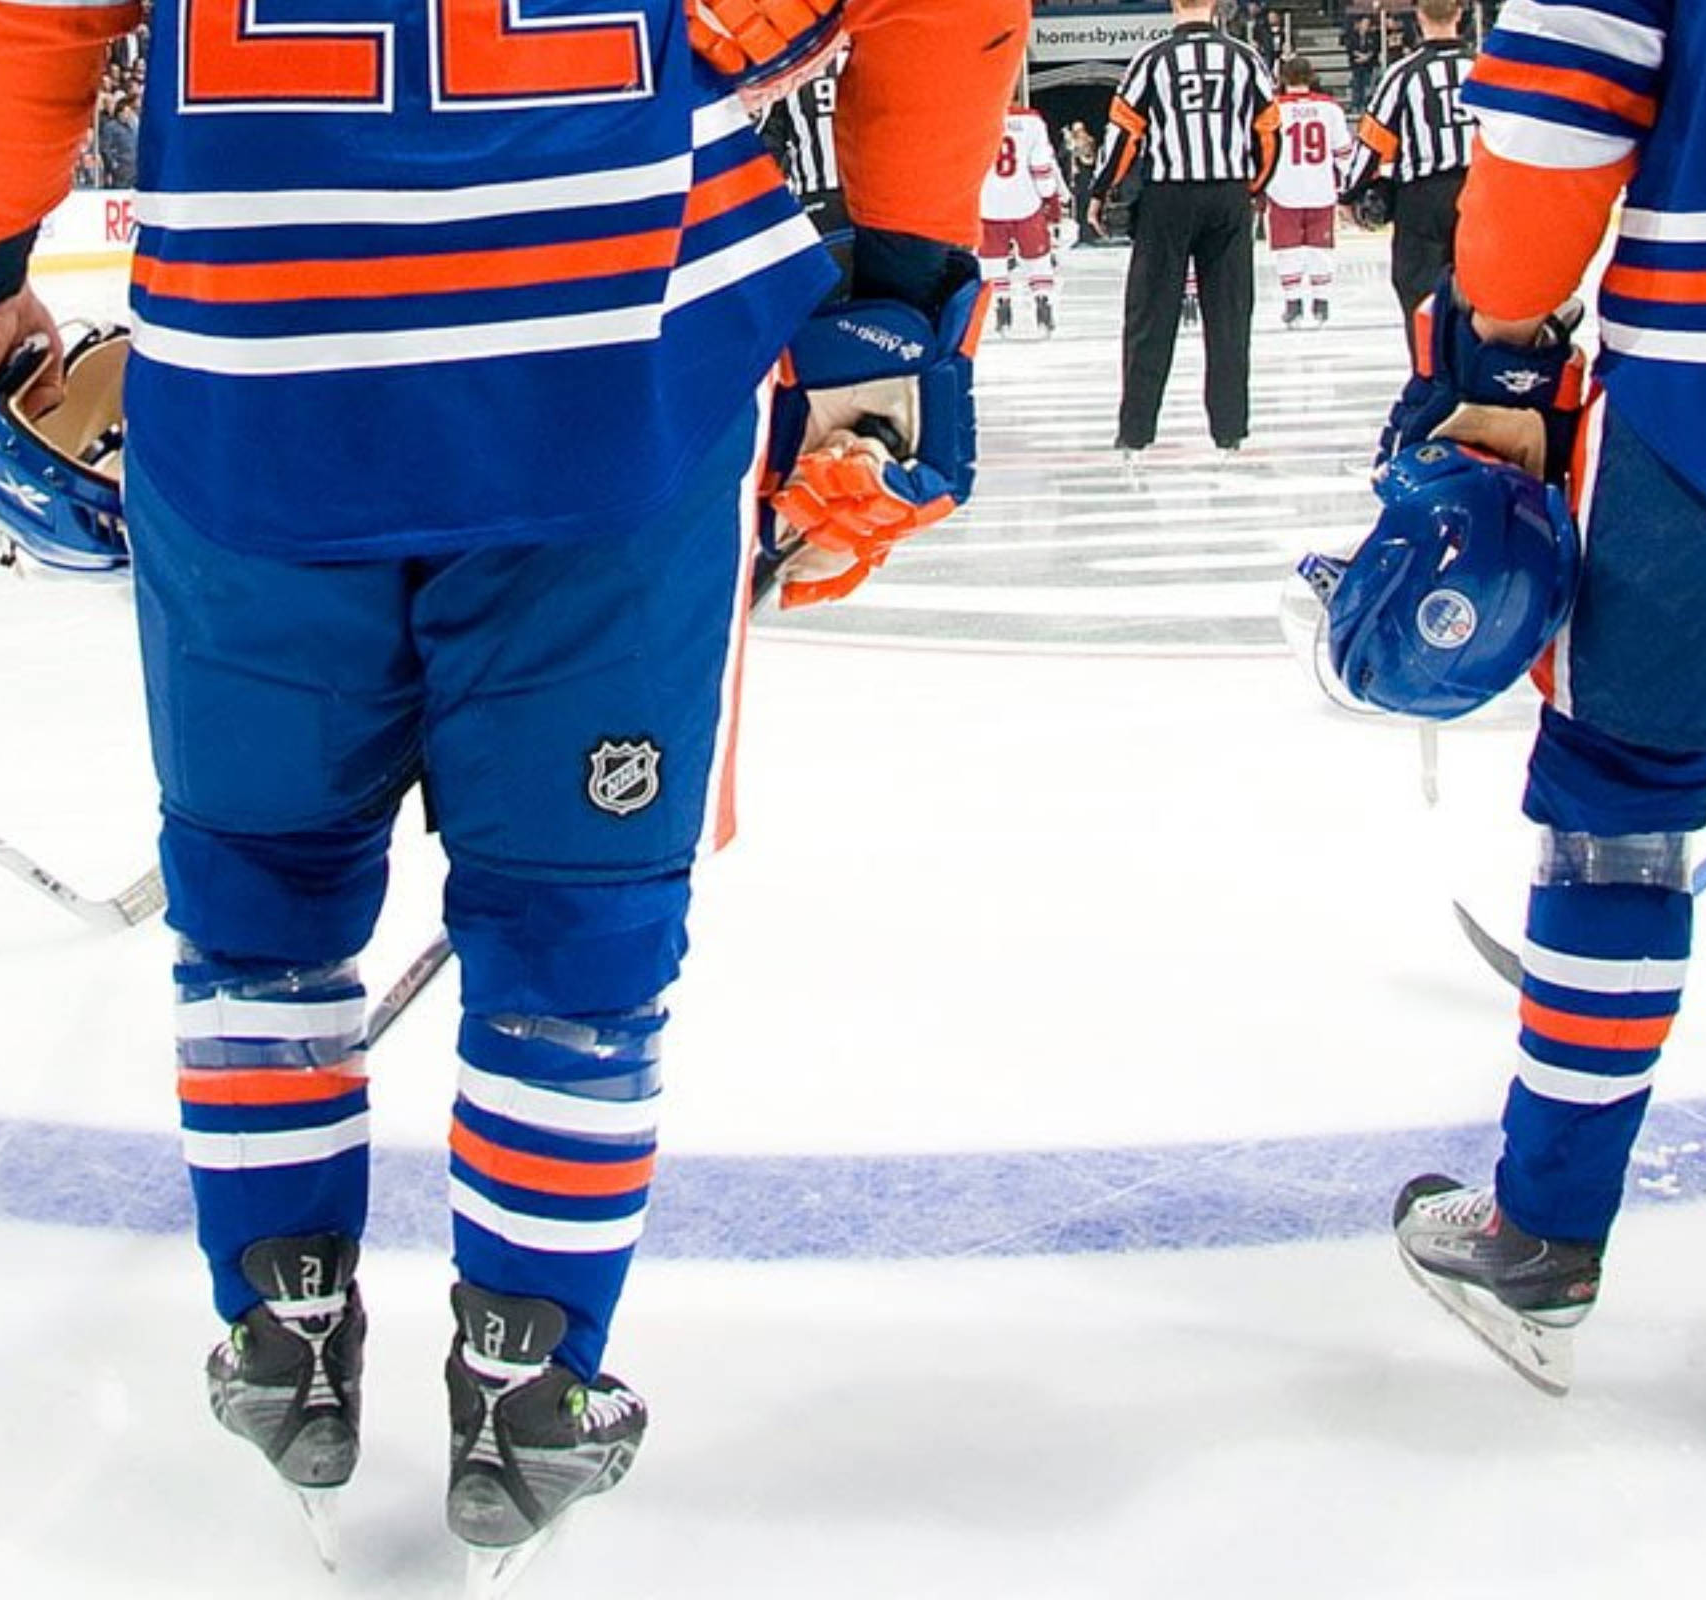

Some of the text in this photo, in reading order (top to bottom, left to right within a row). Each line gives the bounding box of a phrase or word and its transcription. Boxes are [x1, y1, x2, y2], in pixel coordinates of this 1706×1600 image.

[1036, 27, 1175, 47] homesbyavi.co
[1178, 73, 1225, 110] 27
[1285, 121, 1326, 165] 19
